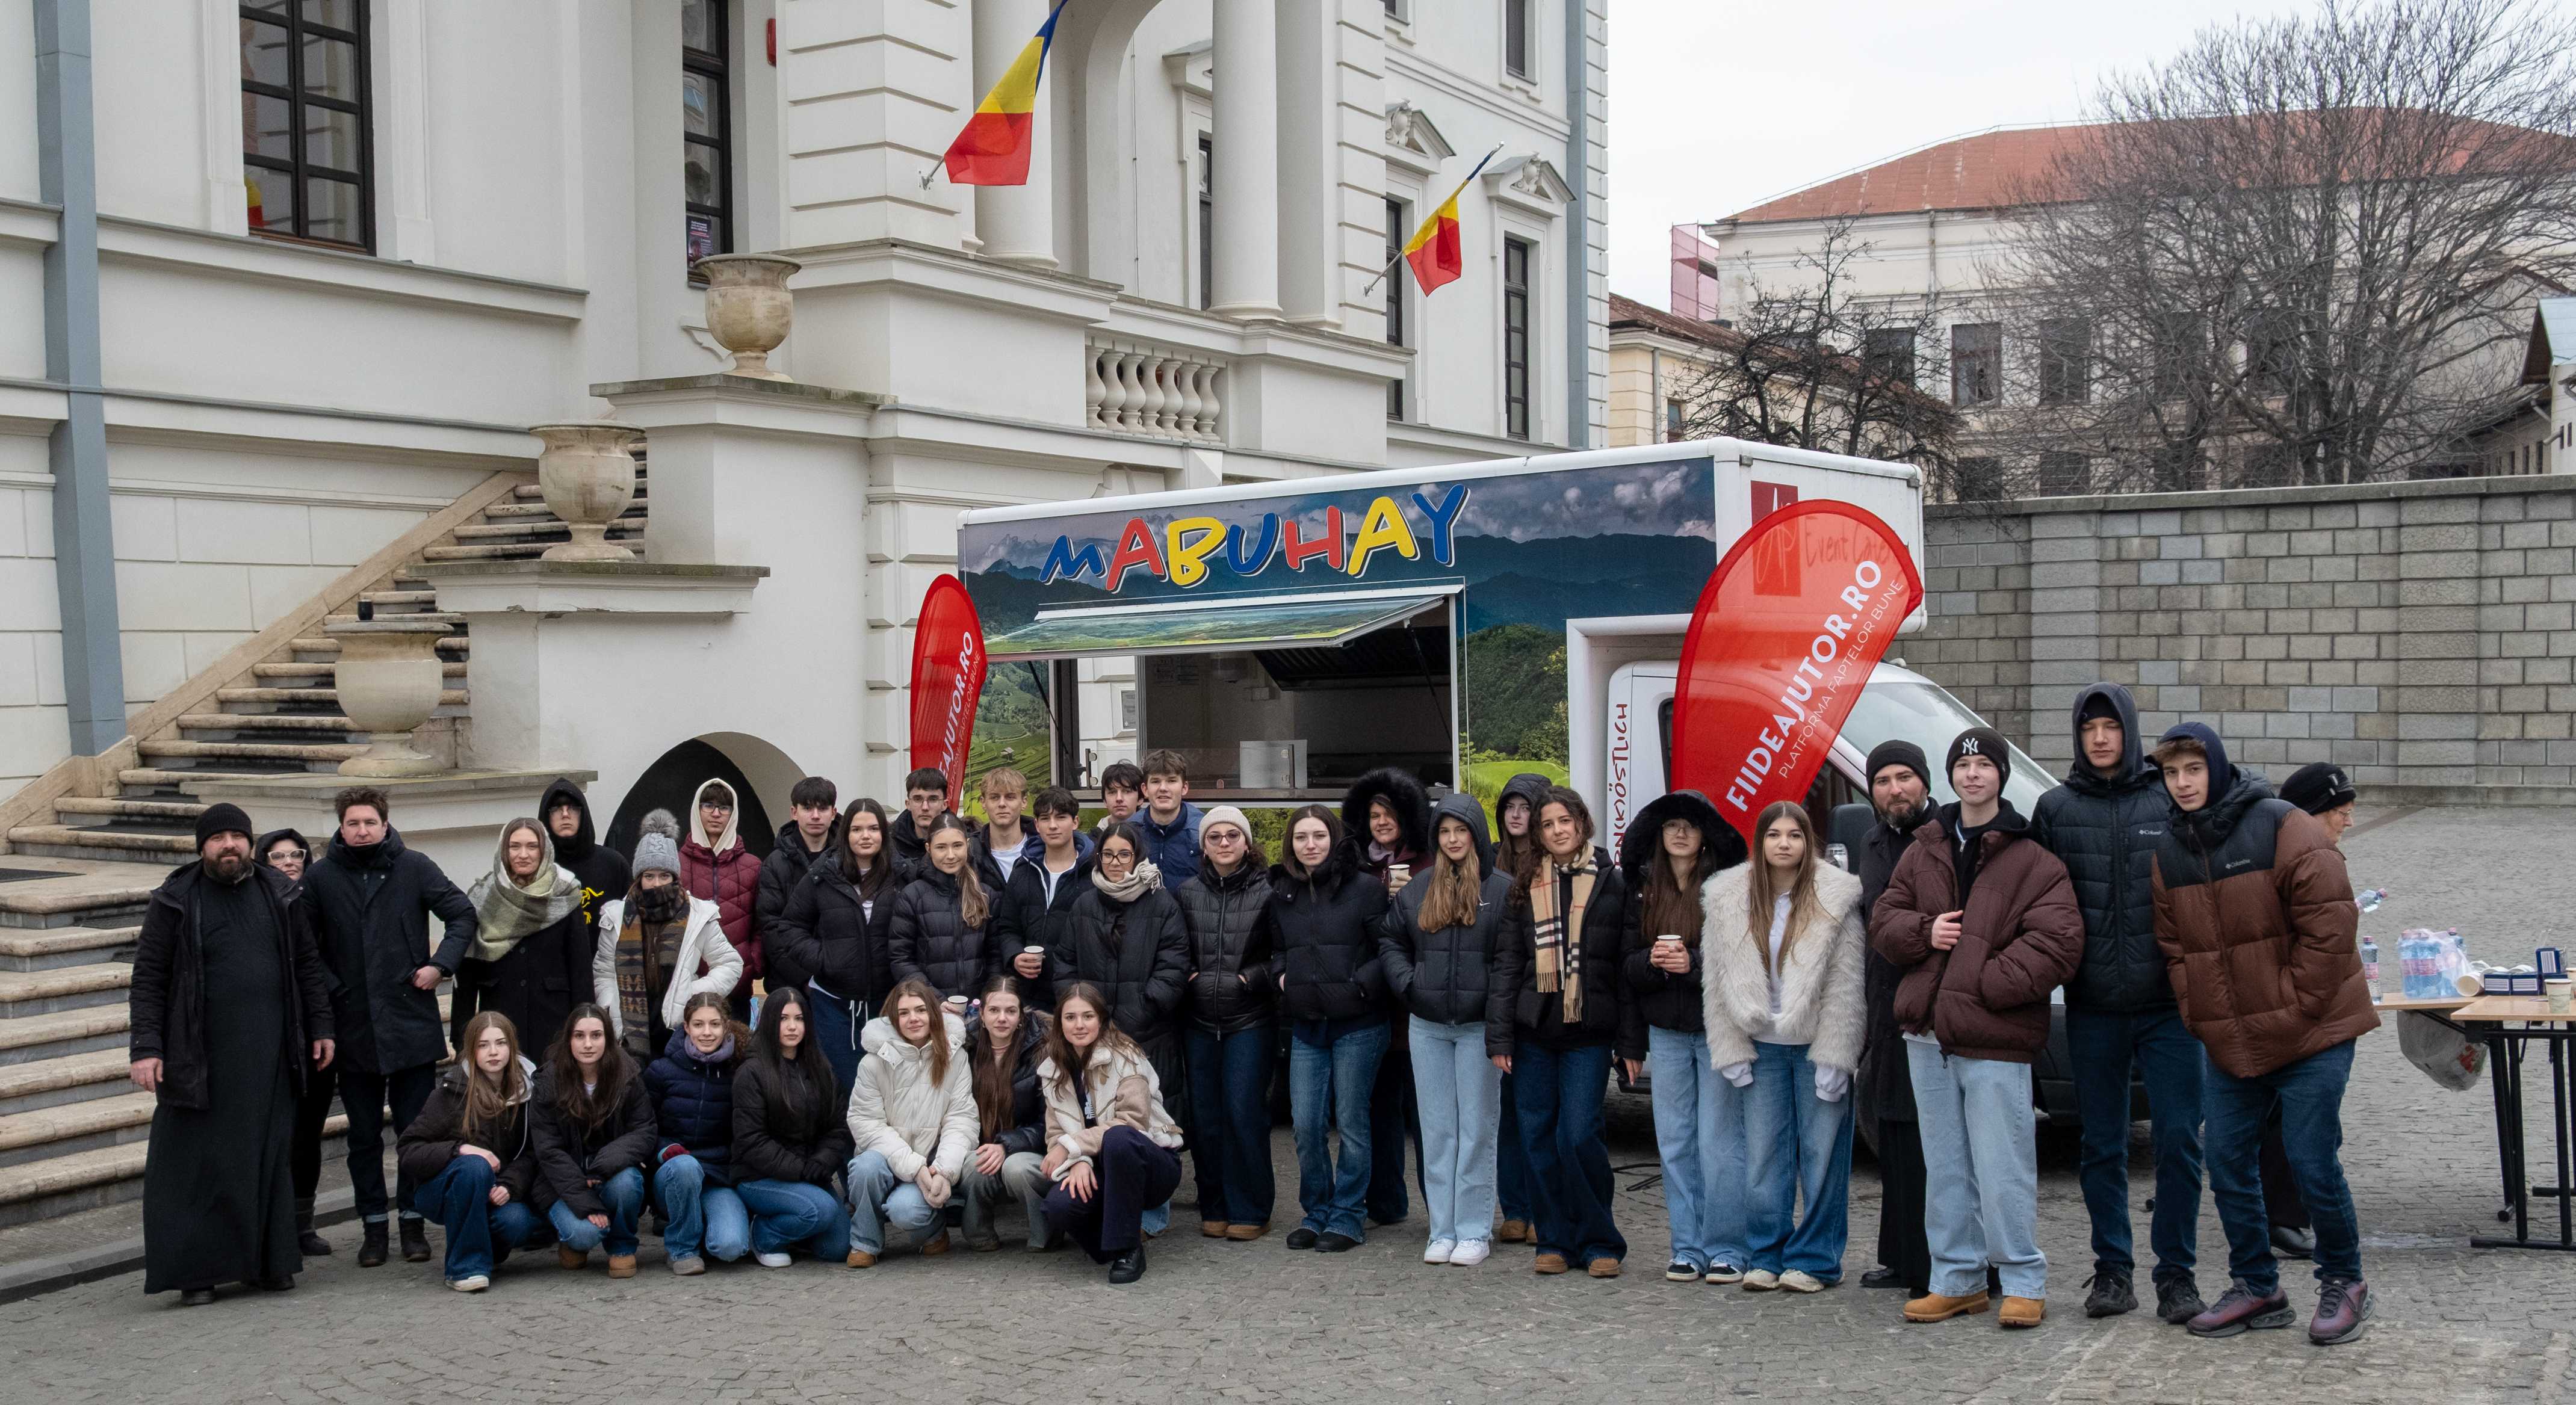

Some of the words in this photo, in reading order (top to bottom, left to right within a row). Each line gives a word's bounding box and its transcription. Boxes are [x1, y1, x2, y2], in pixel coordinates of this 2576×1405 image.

[1038, 484, 1470, 594] MABUHAY
[939, 631, 973, 780] EAJUTOR.RO
[1726, 560, 1881, 812] FIIDEAJUTOR.RO
[1778, 695, 1833, 779] PLATFORMA
[1827, 620, 1875, 693] FAPTELOR
[1870, 579, 1904, 621] BUNE
[1962, 737, 1979, 755] NY
